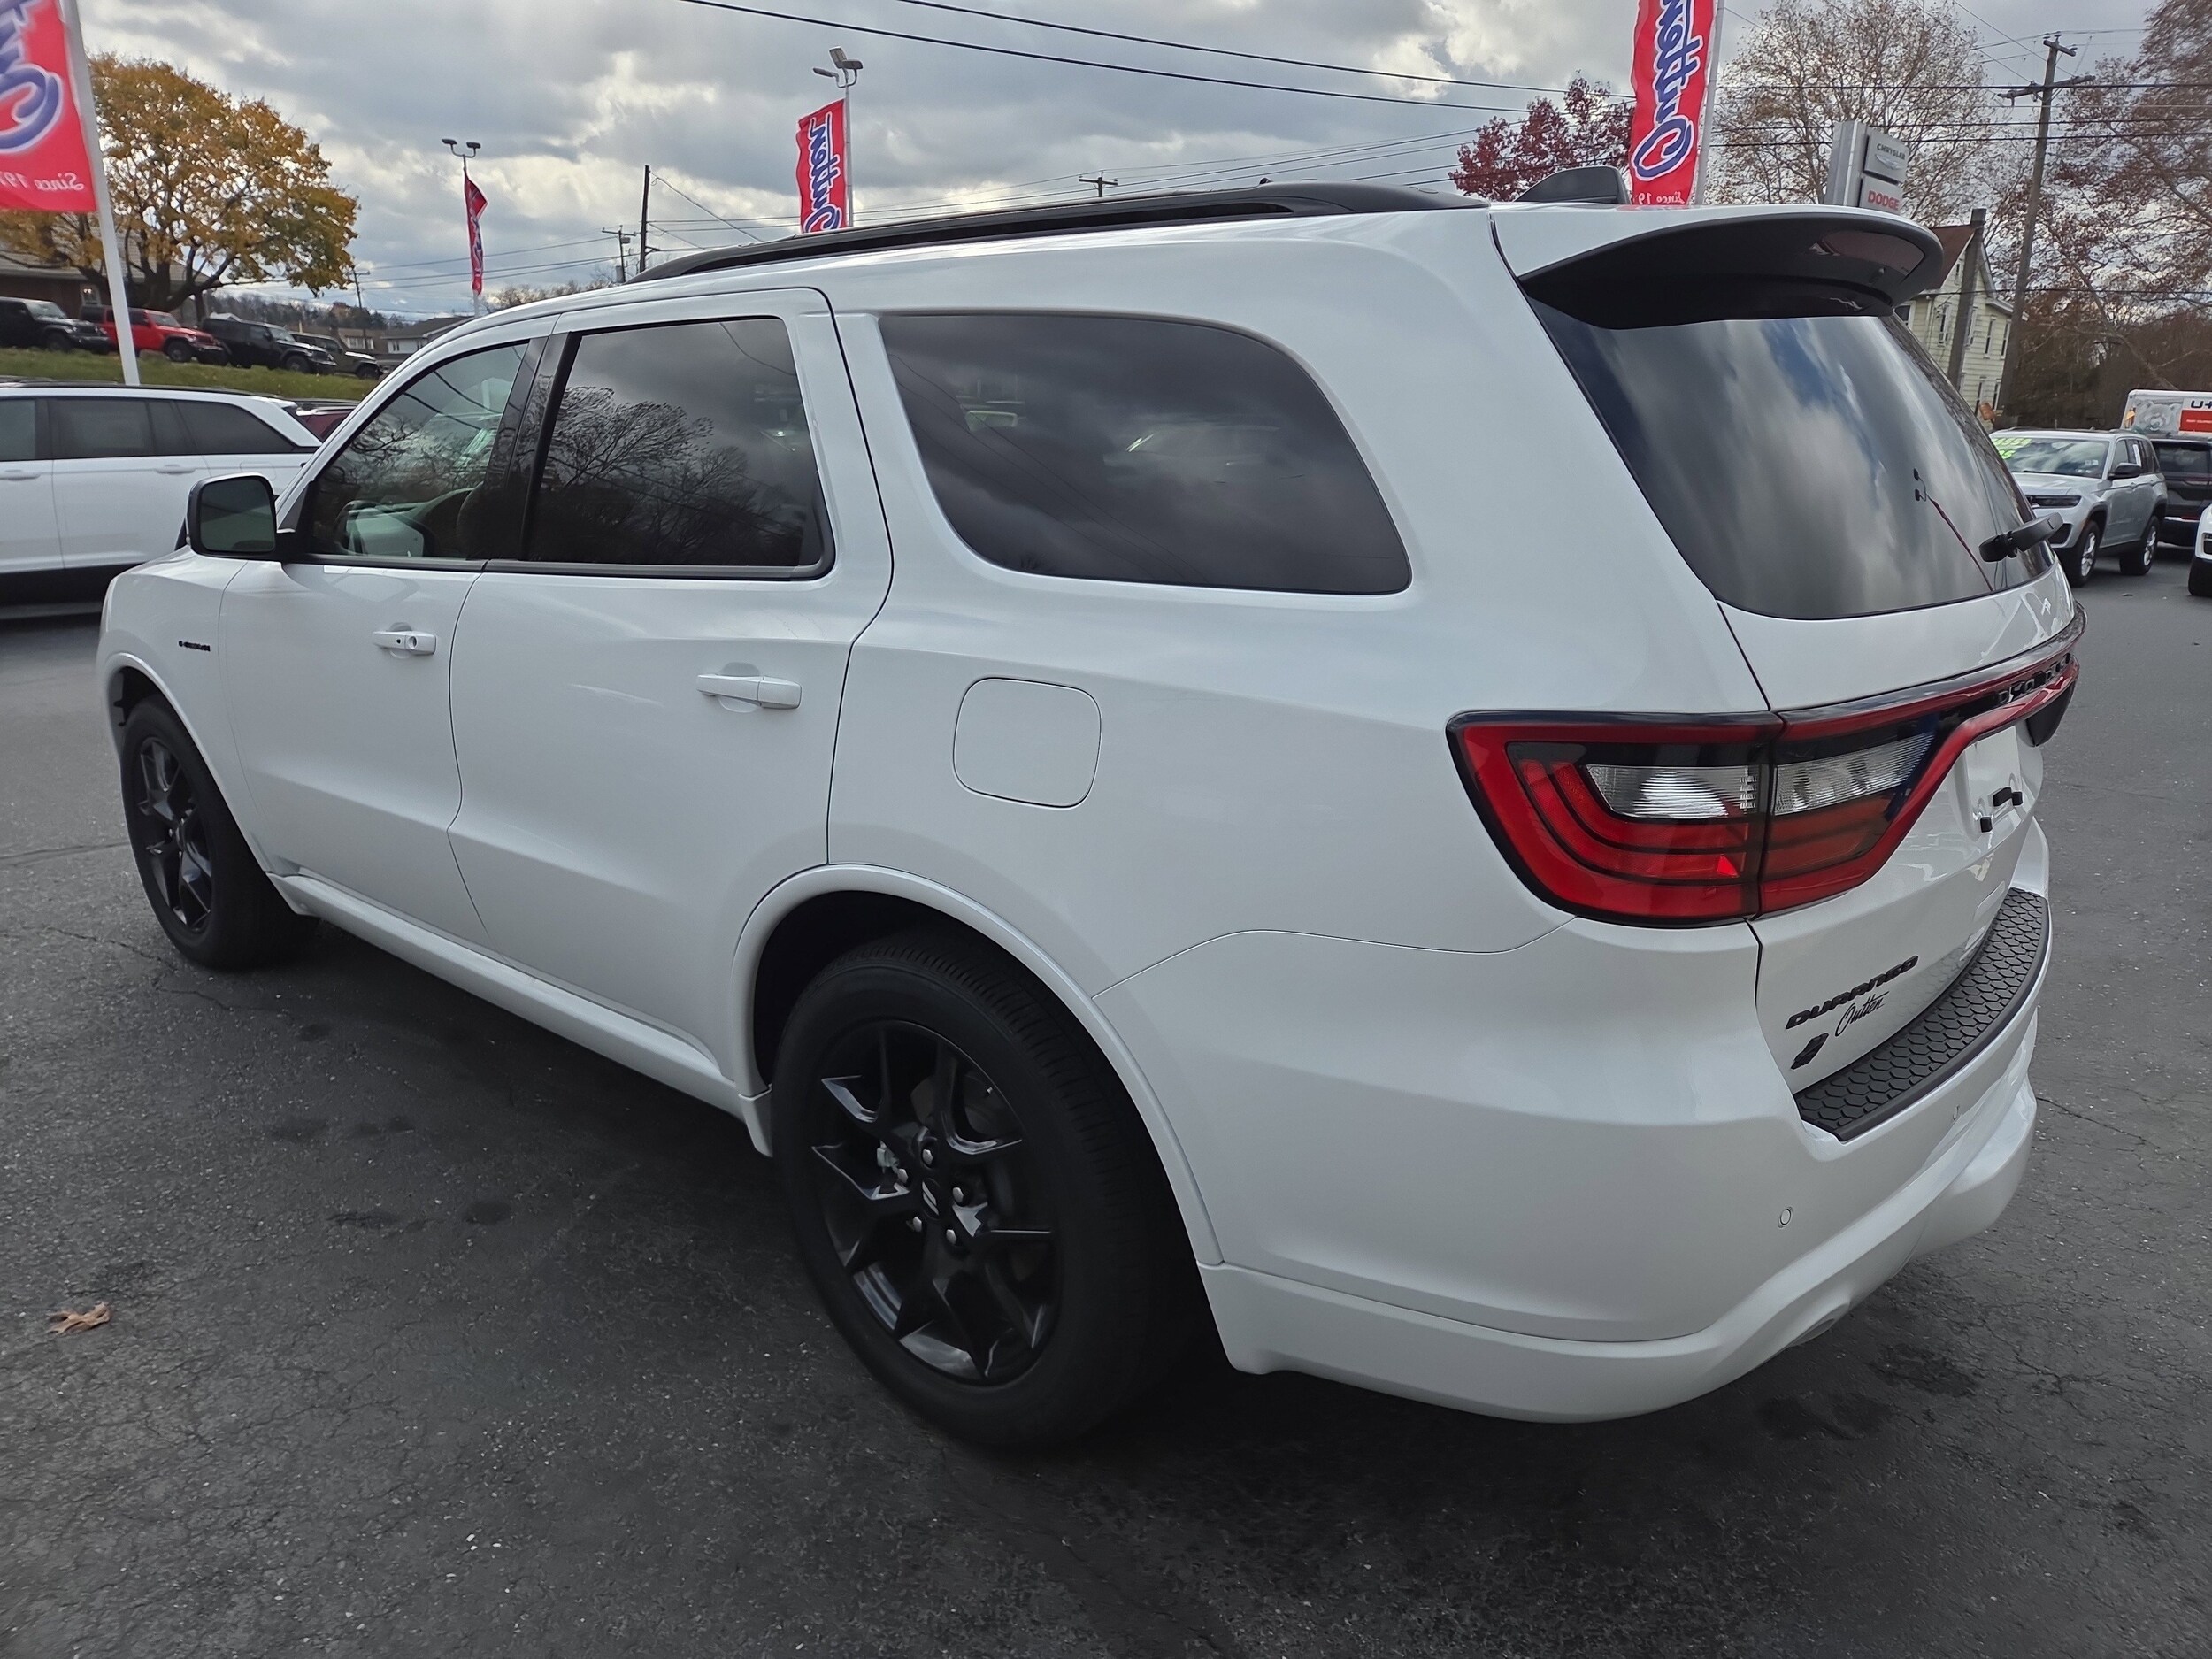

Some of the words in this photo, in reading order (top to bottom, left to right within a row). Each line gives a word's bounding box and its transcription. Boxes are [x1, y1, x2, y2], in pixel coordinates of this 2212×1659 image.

[1876, 142, 1906, 160] CHRYSLER
[1867, 189, 1900, 211] DODGE
[1786, 955, 1919, 1030] DURANGO
[1834, 990, 1890, 1037] Outten
